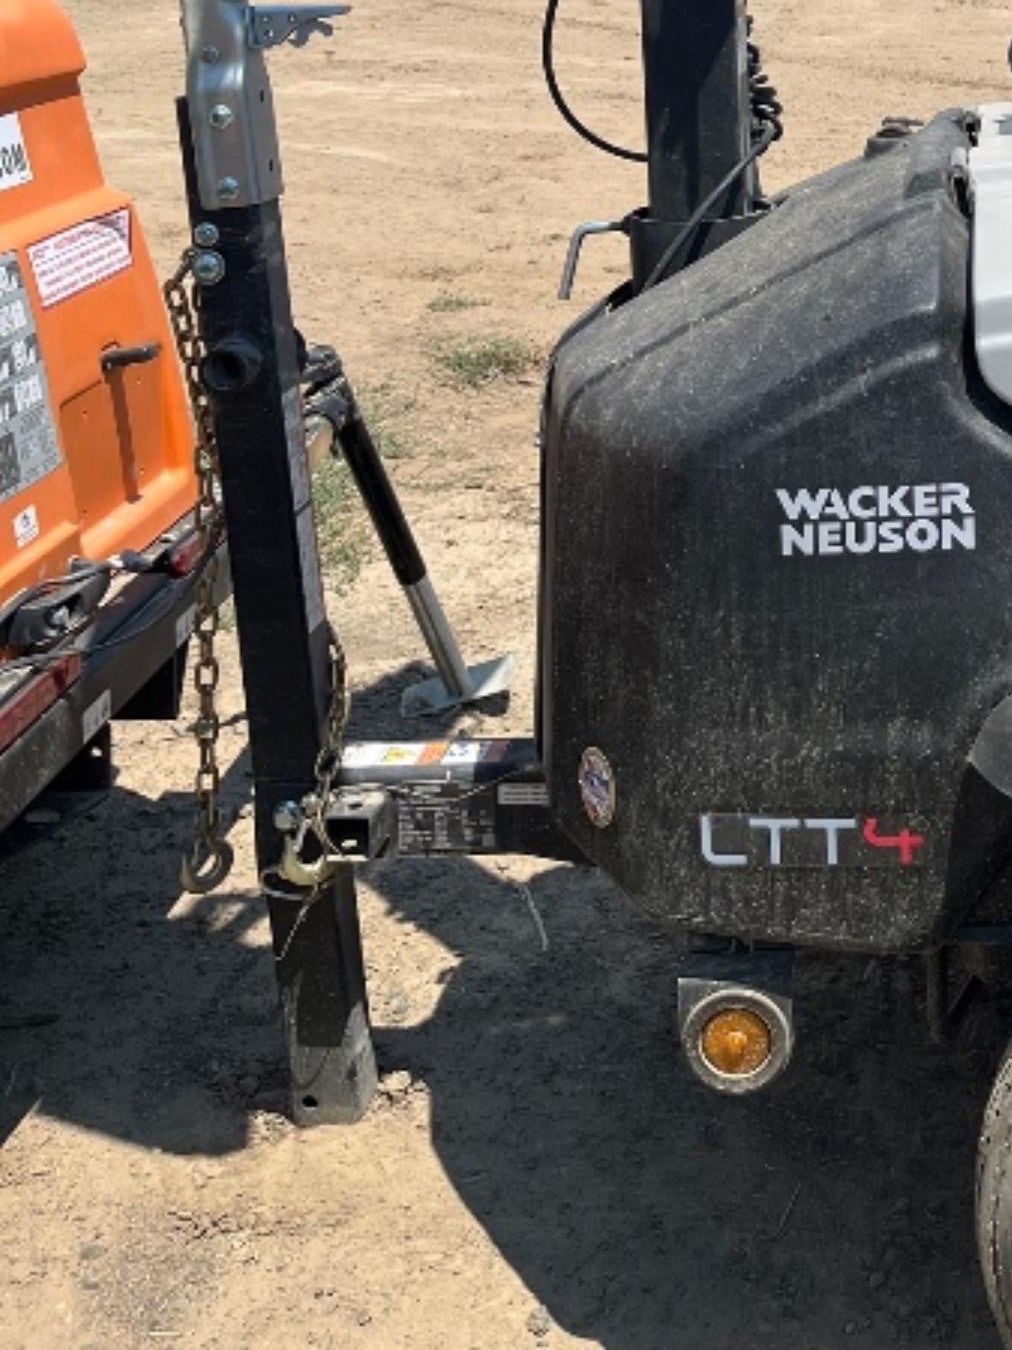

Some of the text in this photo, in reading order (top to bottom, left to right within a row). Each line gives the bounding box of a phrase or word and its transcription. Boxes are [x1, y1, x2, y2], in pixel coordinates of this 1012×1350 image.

[774, 482, 976, 520] WACKER
[780, 516, 976, 556] NEUSON
[700, 812, 924, 865] LTT4
